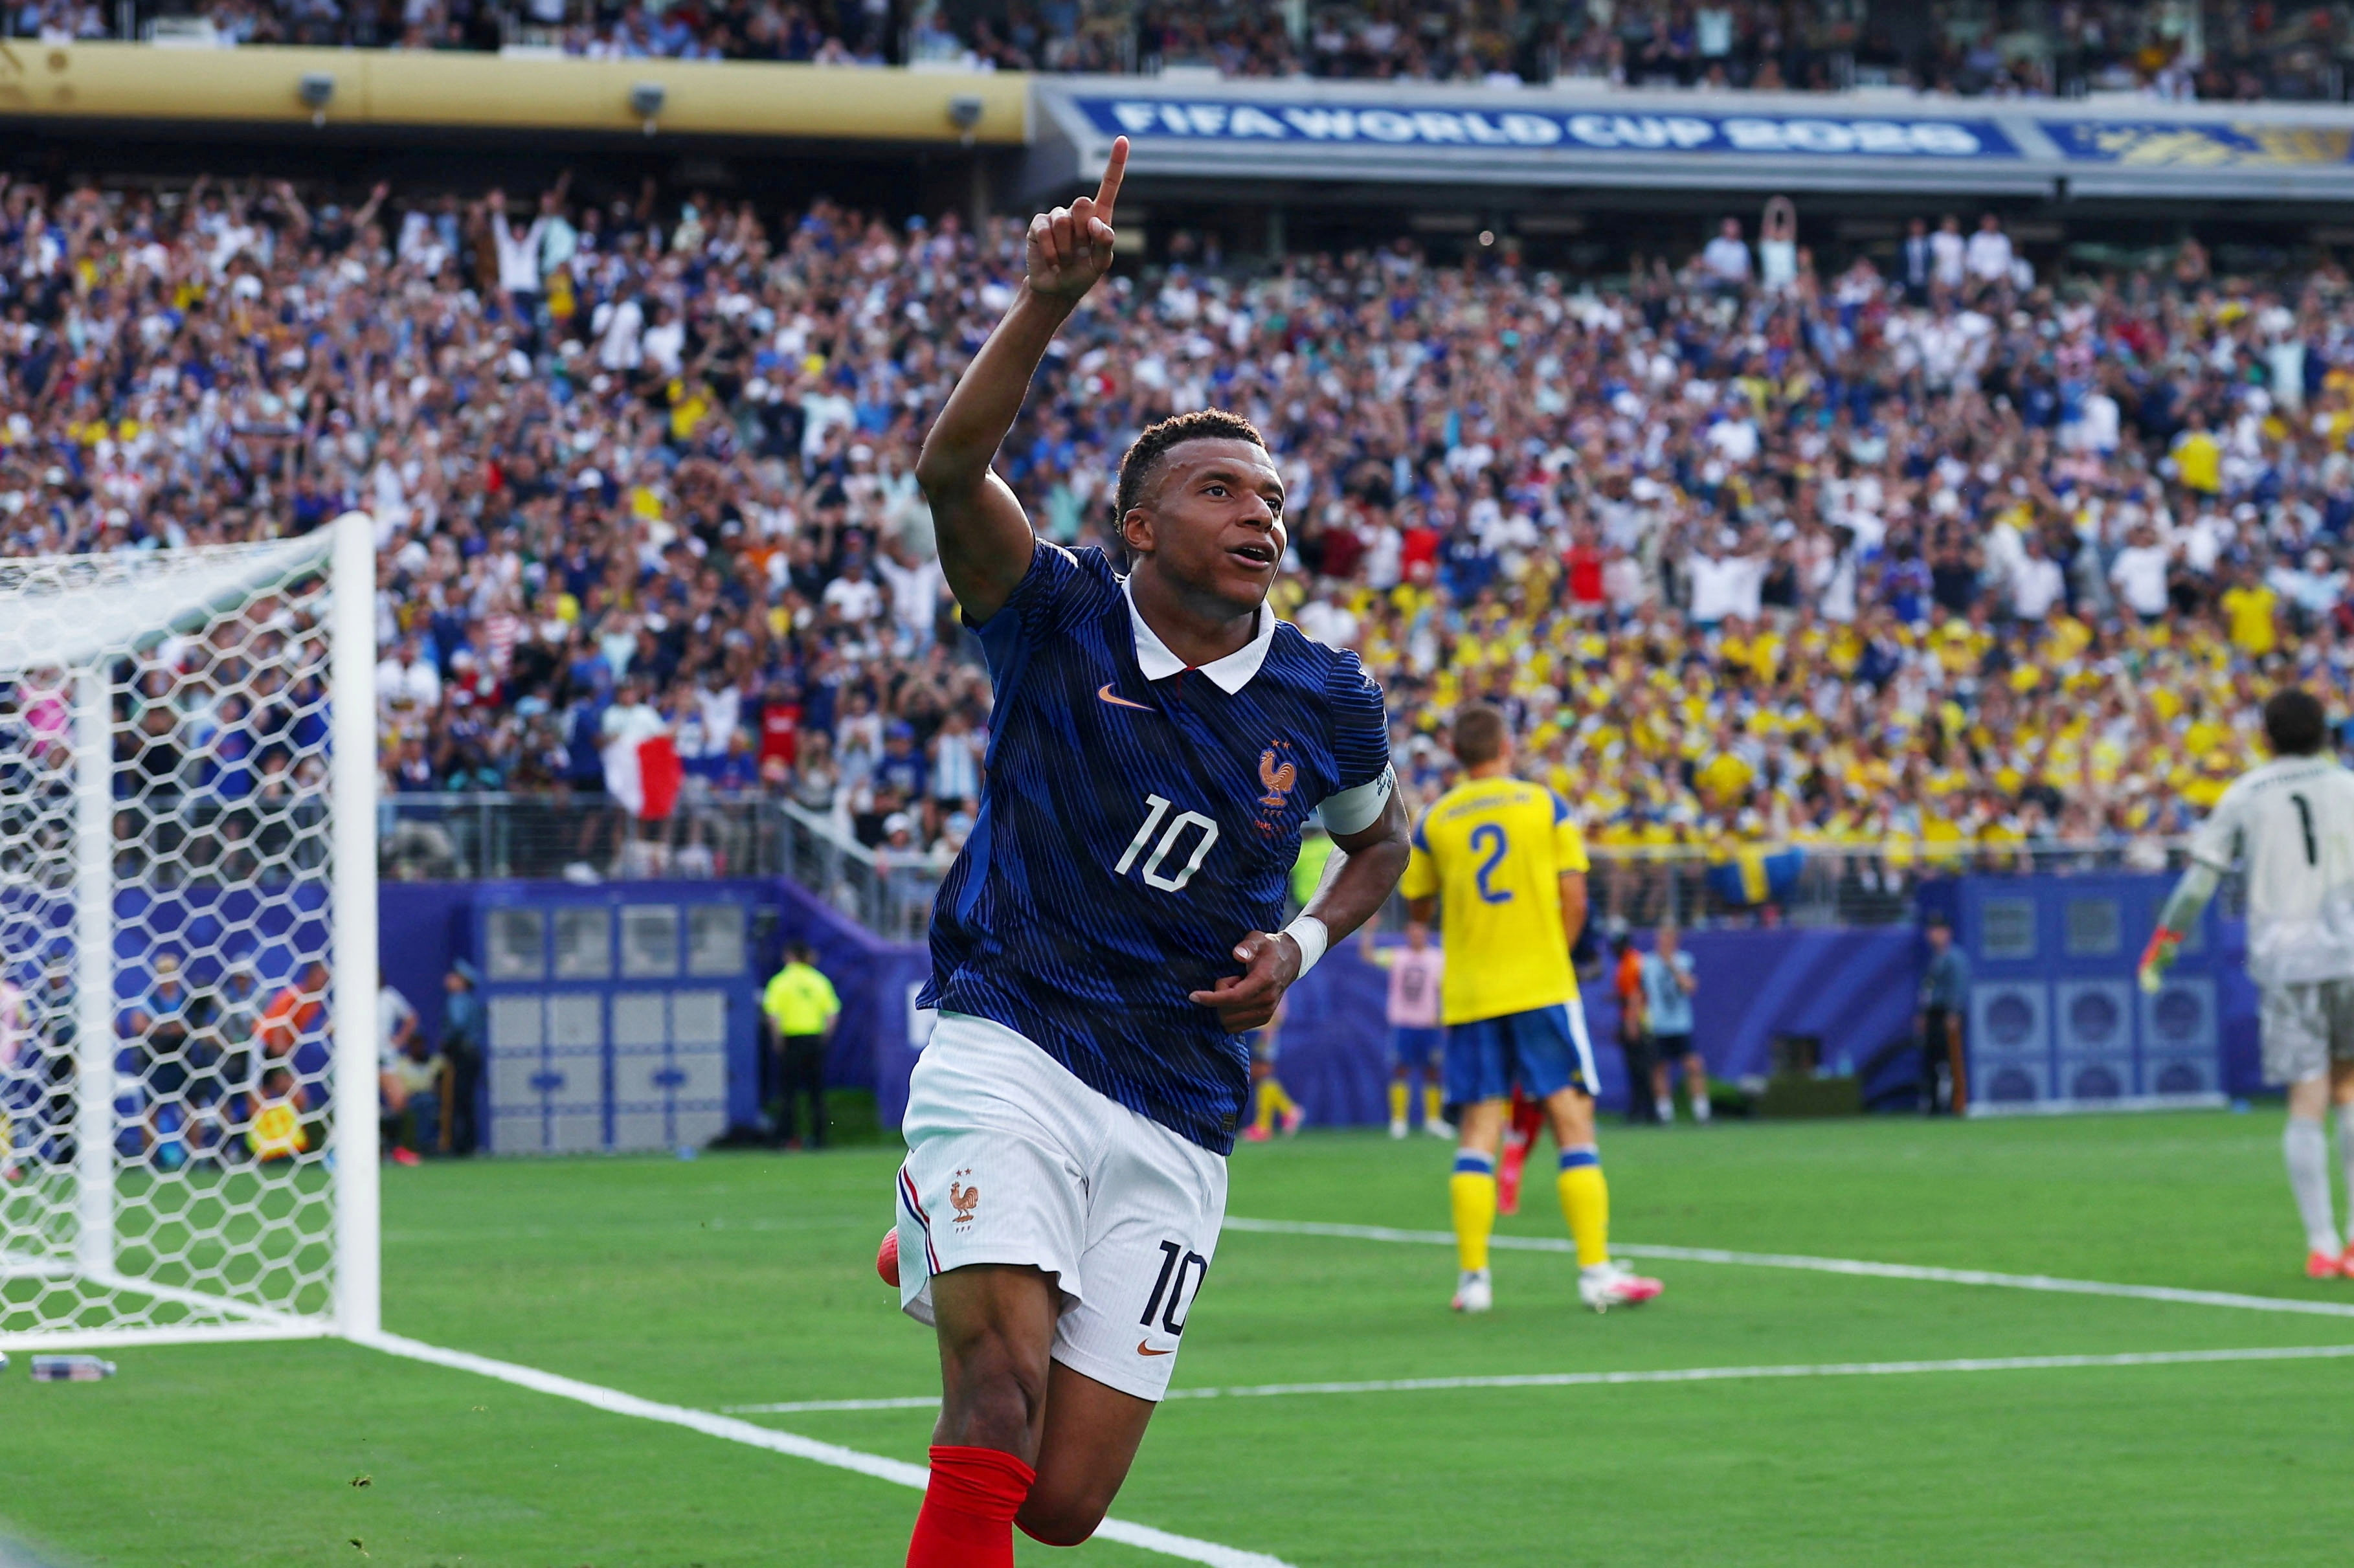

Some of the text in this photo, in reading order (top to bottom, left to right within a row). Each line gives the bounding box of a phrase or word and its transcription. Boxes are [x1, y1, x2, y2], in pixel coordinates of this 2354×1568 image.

[1112, 100, 1286, 138] FIFA
[1281, 105, 1562, 145] WORLD
[1567, 114, 1715, 148] CUP
[1114, 794, 1219, 893] 10
[1470, 823, 1513, 904] 2
[2291, 792, 2318, 866] 1
[1139, 1239, 1208, 1337] 10
